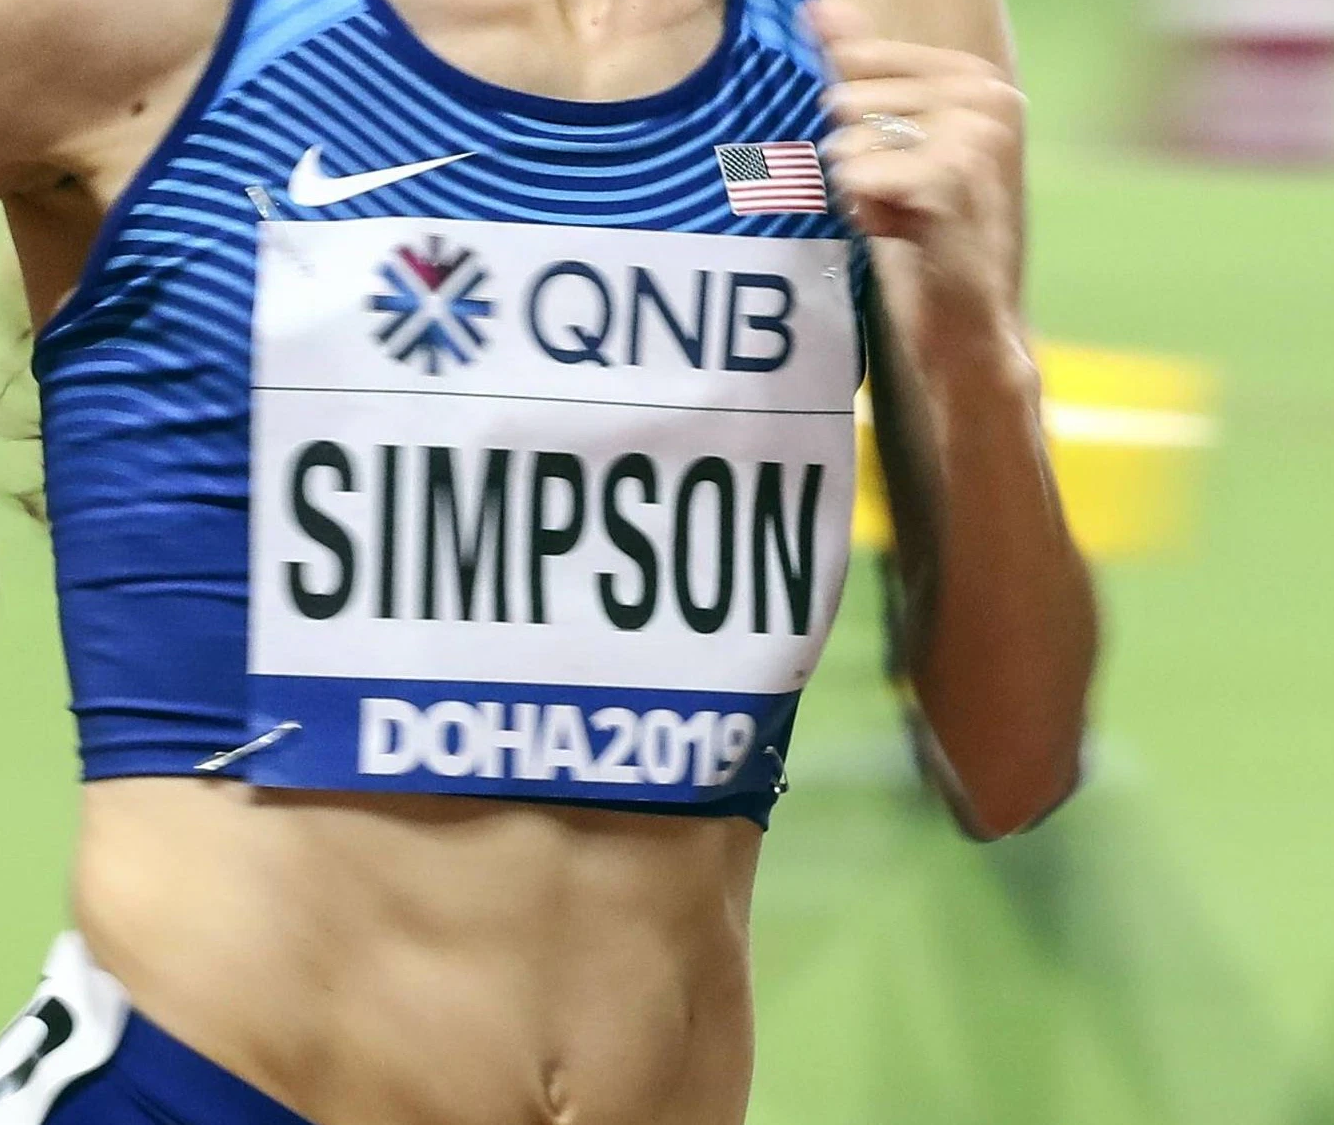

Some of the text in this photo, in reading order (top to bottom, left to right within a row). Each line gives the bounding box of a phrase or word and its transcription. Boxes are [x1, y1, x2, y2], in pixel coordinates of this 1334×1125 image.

[526, 259, 797, 373] QNB
[280, 438, 826, 638] SIMPSON
[357, 696, 758, 786] DOHA2019
